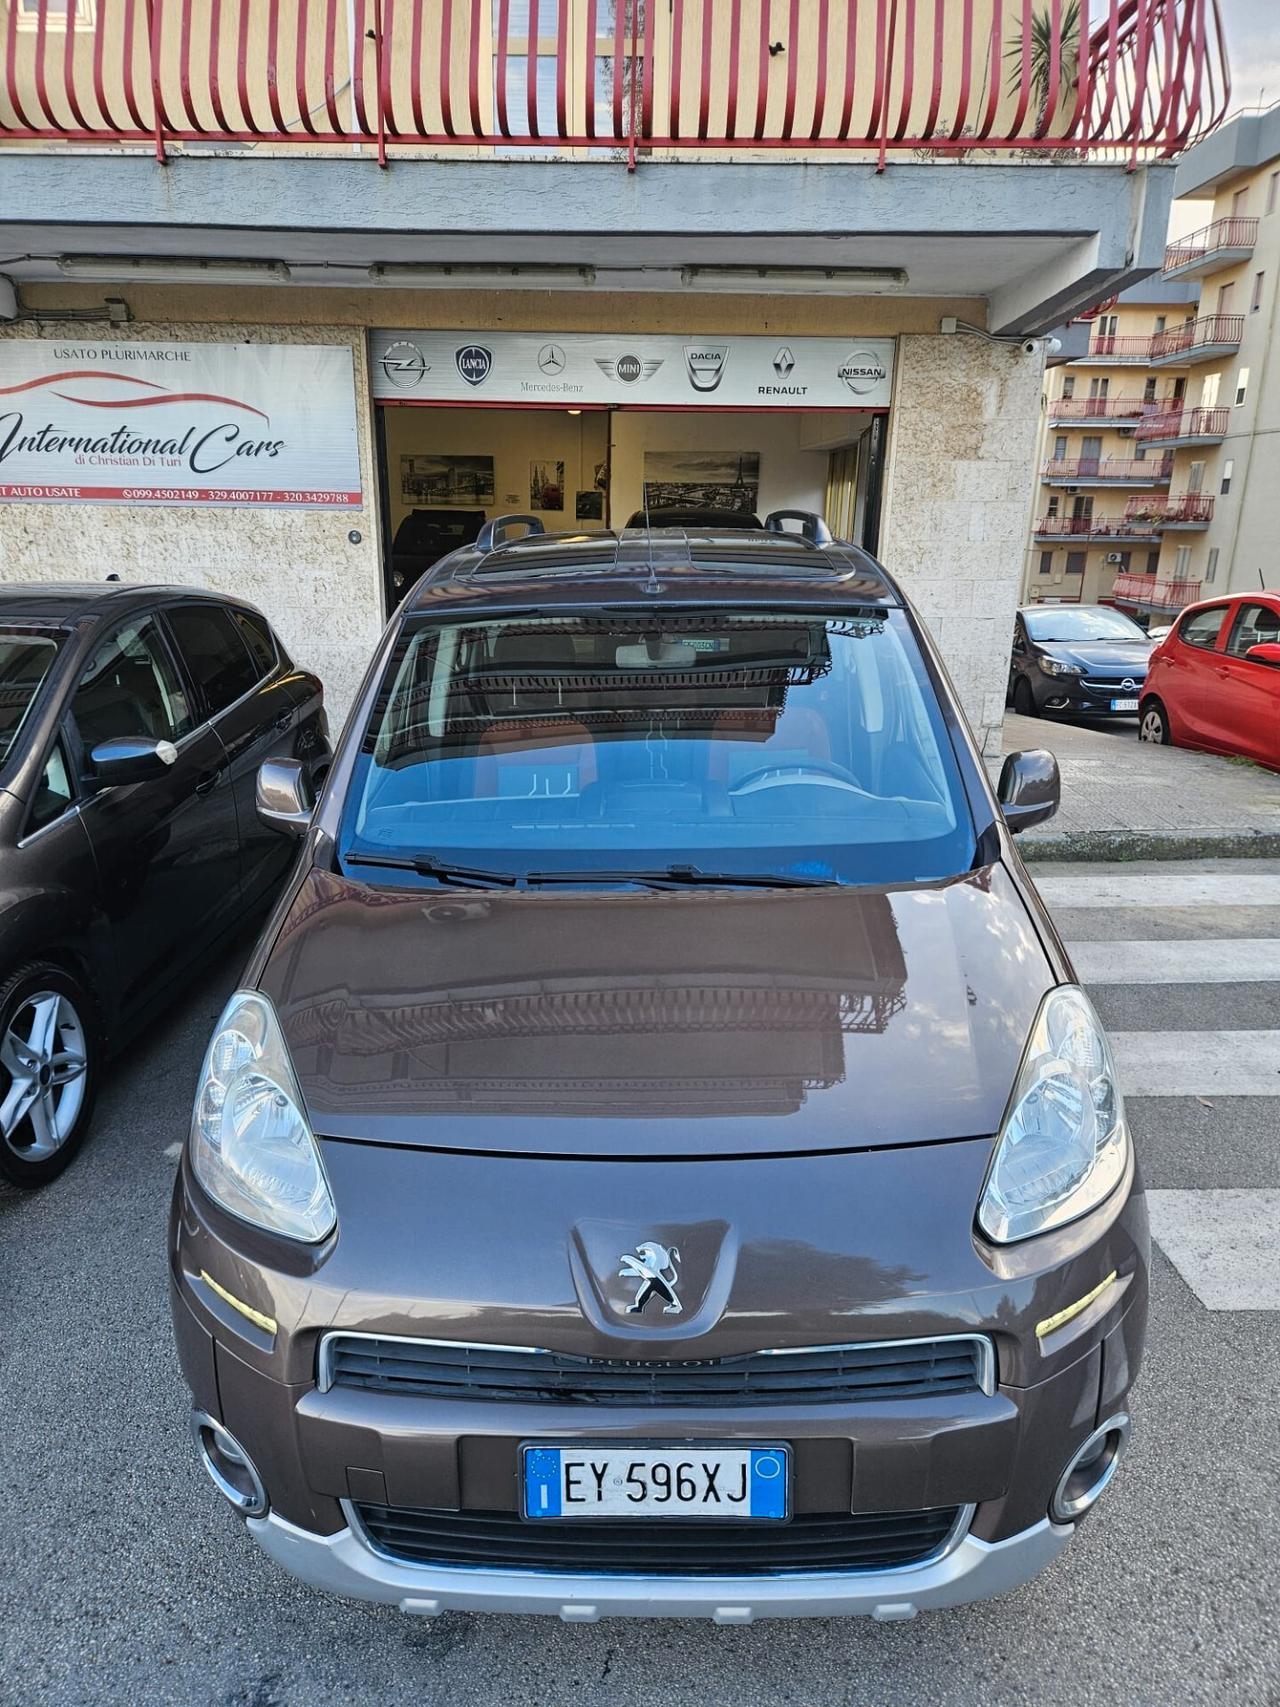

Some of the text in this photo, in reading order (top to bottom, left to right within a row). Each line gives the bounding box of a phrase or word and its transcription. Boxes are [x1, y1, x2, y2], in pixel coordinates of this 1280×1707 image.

[53, 348, 192, 362] USATO PLURIMARCHE
[690, 352, 721, 361] DACIA
[462, 358, 487, 371] LANCIA
[618, 364, 640, 375] MINI
[842, 367, 882, 377] NISSAN
[520, 382, 584, 393] Mercedes-Benz
[758, 386, 808, 395] RENAULT
[0, 412, 288, 474] International Cars
[74, 454, 182, 467] di Christian Di Turi
[11, 487, 43, 496] AUTO
[45, 487, 81, 497] USATE
[133, 490, 199, 500] 099.4502149
[208, 491, 273, 501] 329.4007177
[283, 491, 349, 503] 320.3429788
[588, 1358, 715, 1367] PEUGEOT
[564, 1462, 747, 1502] EY 596XJ
